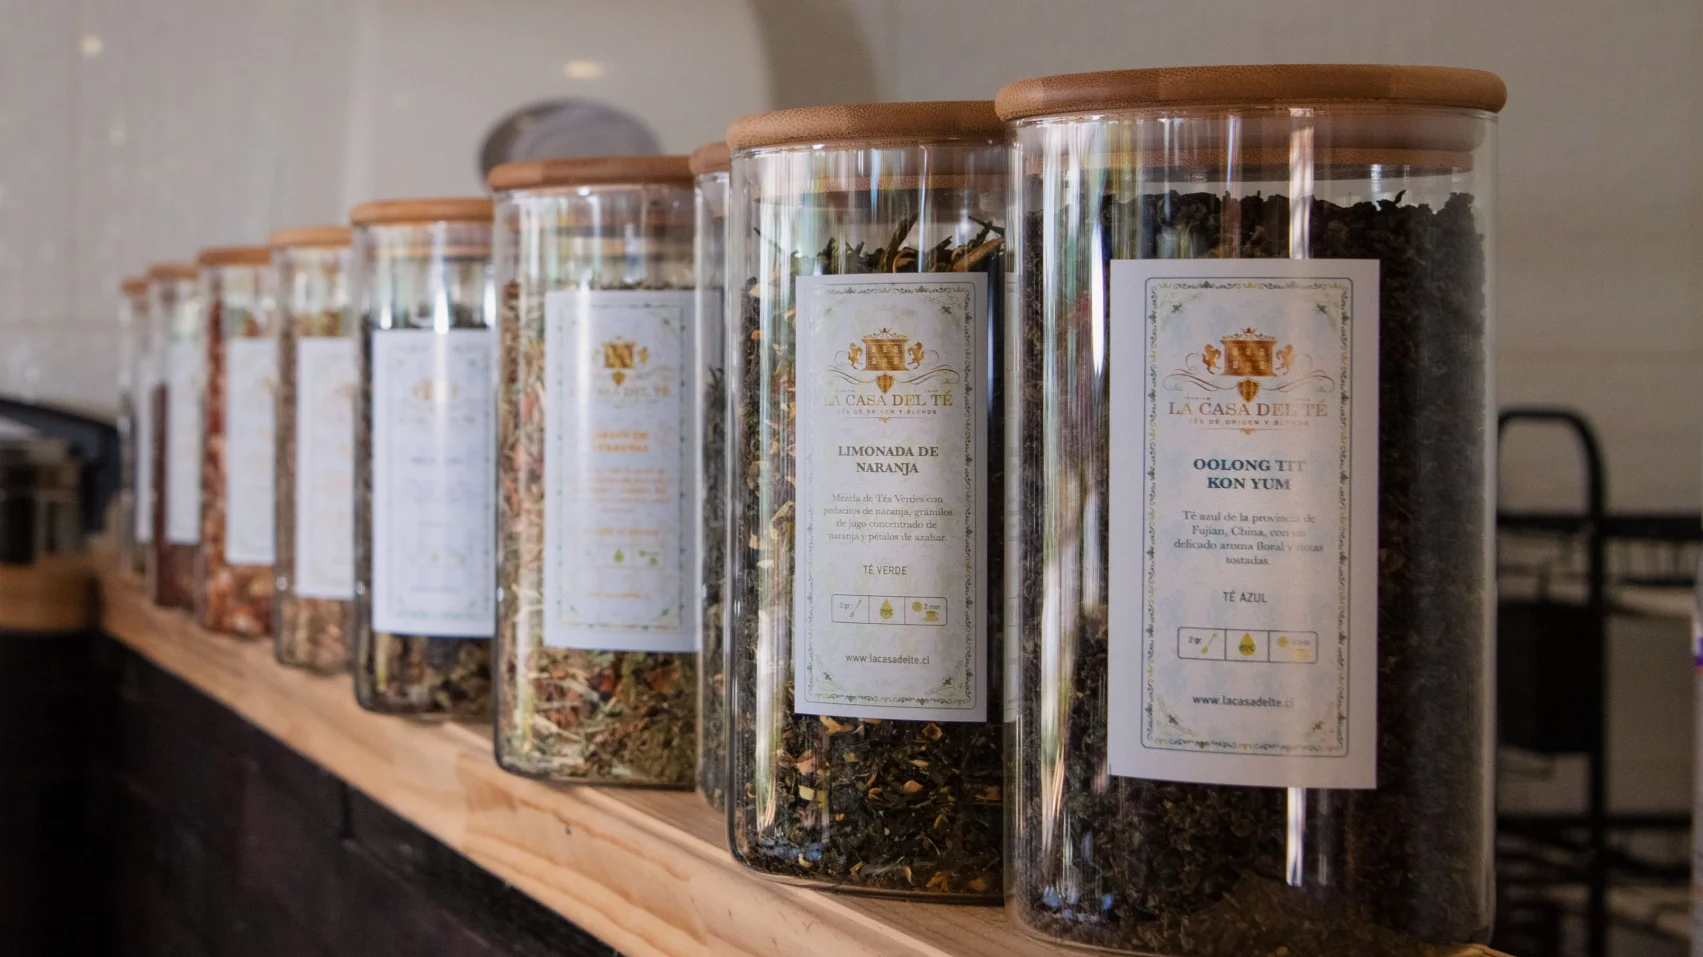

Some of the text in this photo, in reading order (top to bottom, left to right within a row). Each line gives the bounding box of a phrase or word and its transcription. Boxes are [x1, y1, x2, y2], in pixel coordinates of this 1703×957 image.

[824, 390, 953, 407] LA CASA DEL TÉ
[1168, 402, 1192, 415] LA
[1200, 402, 1250, 416] CASA
[1256, 402, 1297, 417] DEL
[1305, 398, 1327, 417] TÉ
[838, 446, 939, 457] LIMONADA DE
[856, 462, 919, 476] NARANJA
[1193, 458, 1271, 472] OOLONG
[1207, 476, 1291, 491] KON YUM
[832, 494, 943, 504] Mezcla de Tés Verdes con
[823, 506, 953, 519] pedacitos de naranja, gránulos
[1182, 510, 1197, 520] Té
[1199, 511, 1221, 521] azul
[1224, 511, 1238, 521] de
[1240, 512, 1249, 522] la
[1304, 514, 1316, 524] de
[836, 519, 938, 530] de jugo concentrado de
[828, 532, 947, 543] naranja y pétalos de azahar.
[1192, 525, 1228, 537] Fujian,
[1231, 526, 1267, 538] China,
[1270, 529, 1289, 538] con
[1174, 539, 1217, 550] delicado
[1220, 542, 1254, 551] aroma
[1257, 541, 1285, 552] floral
[1226, 556, 1270, 566] tostadas.
[863, 563, 908, 575] TÉ VERDE
[1223, 590, 1268, 603] TÉ AZUL
[929, 603, 941, 611] min
[845, 654, 930, 665] www.lacasadelte.cl
[1192, 695, 1295, 708] www.lacasadelte.cl
